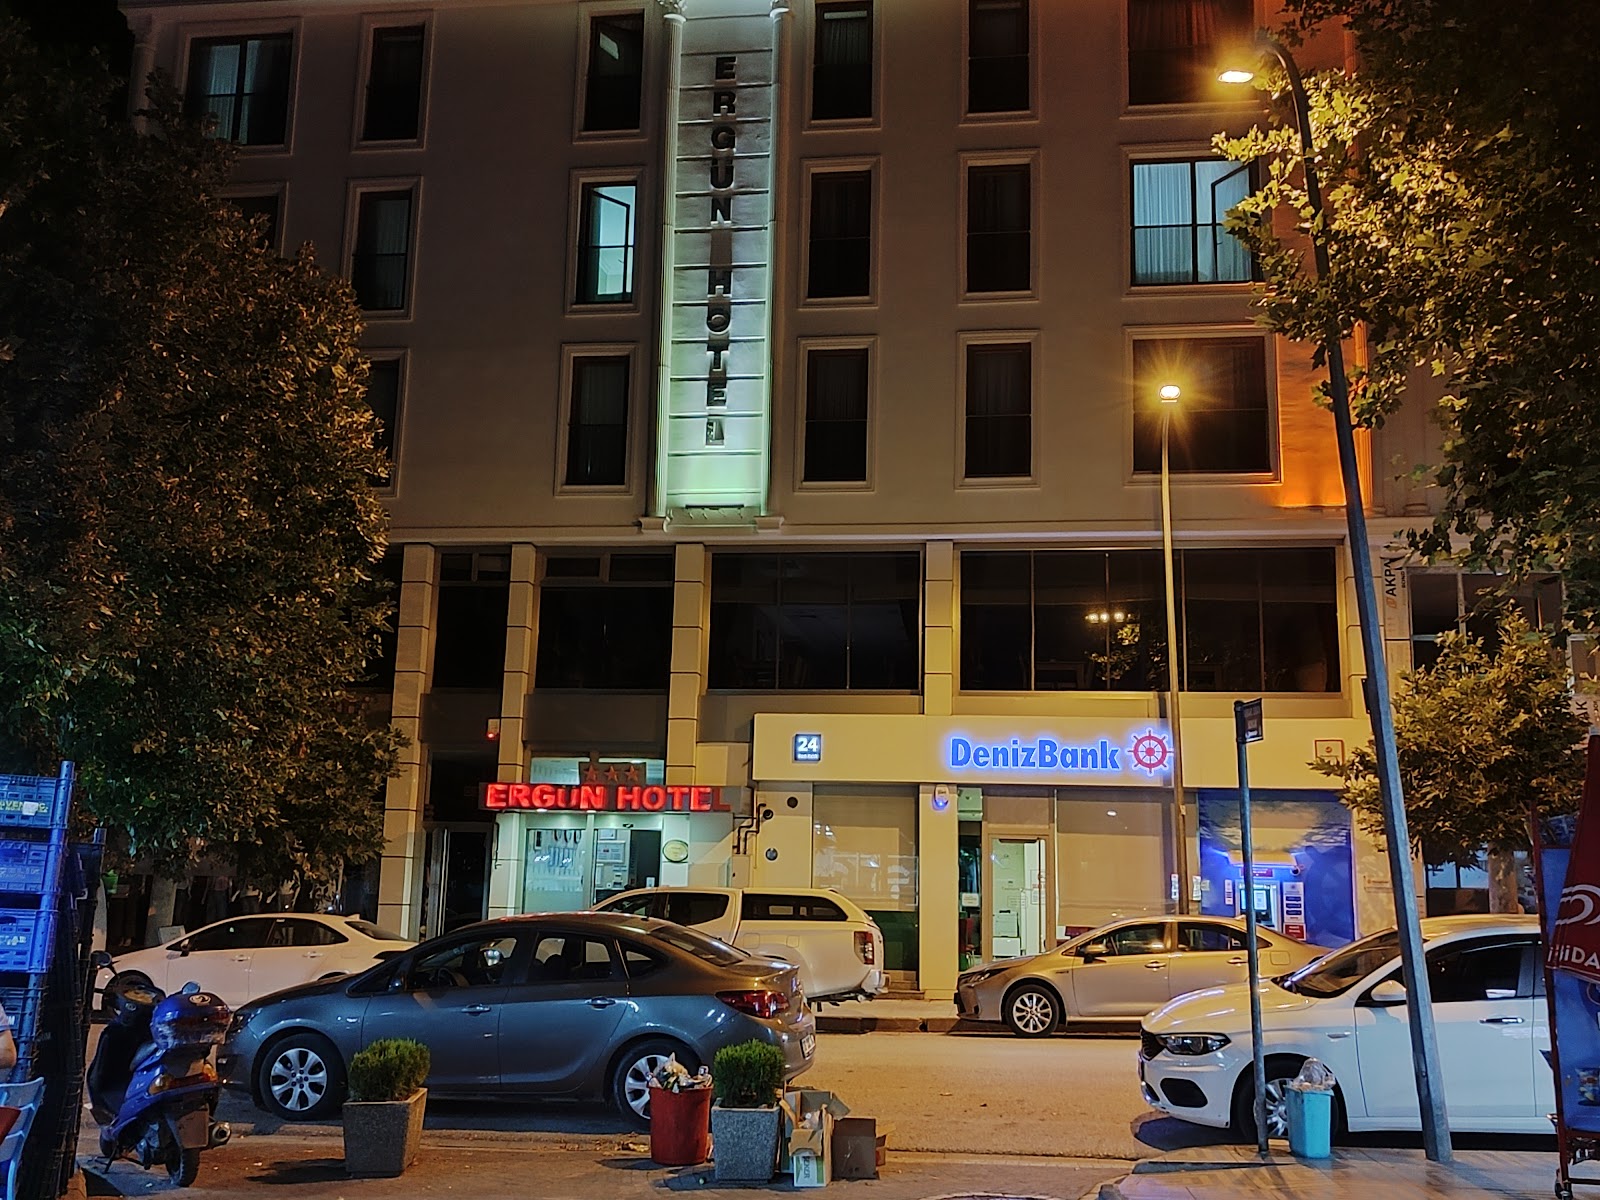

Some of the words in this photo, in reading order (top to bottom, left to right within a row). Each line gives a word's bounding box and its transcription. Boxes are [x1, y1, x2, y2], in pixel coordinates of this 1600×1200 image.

[797, 737, 819, 752] 24
[950, 737, 1120, 769] DenizBank
[616, 786, 731, 811] HOTEL
